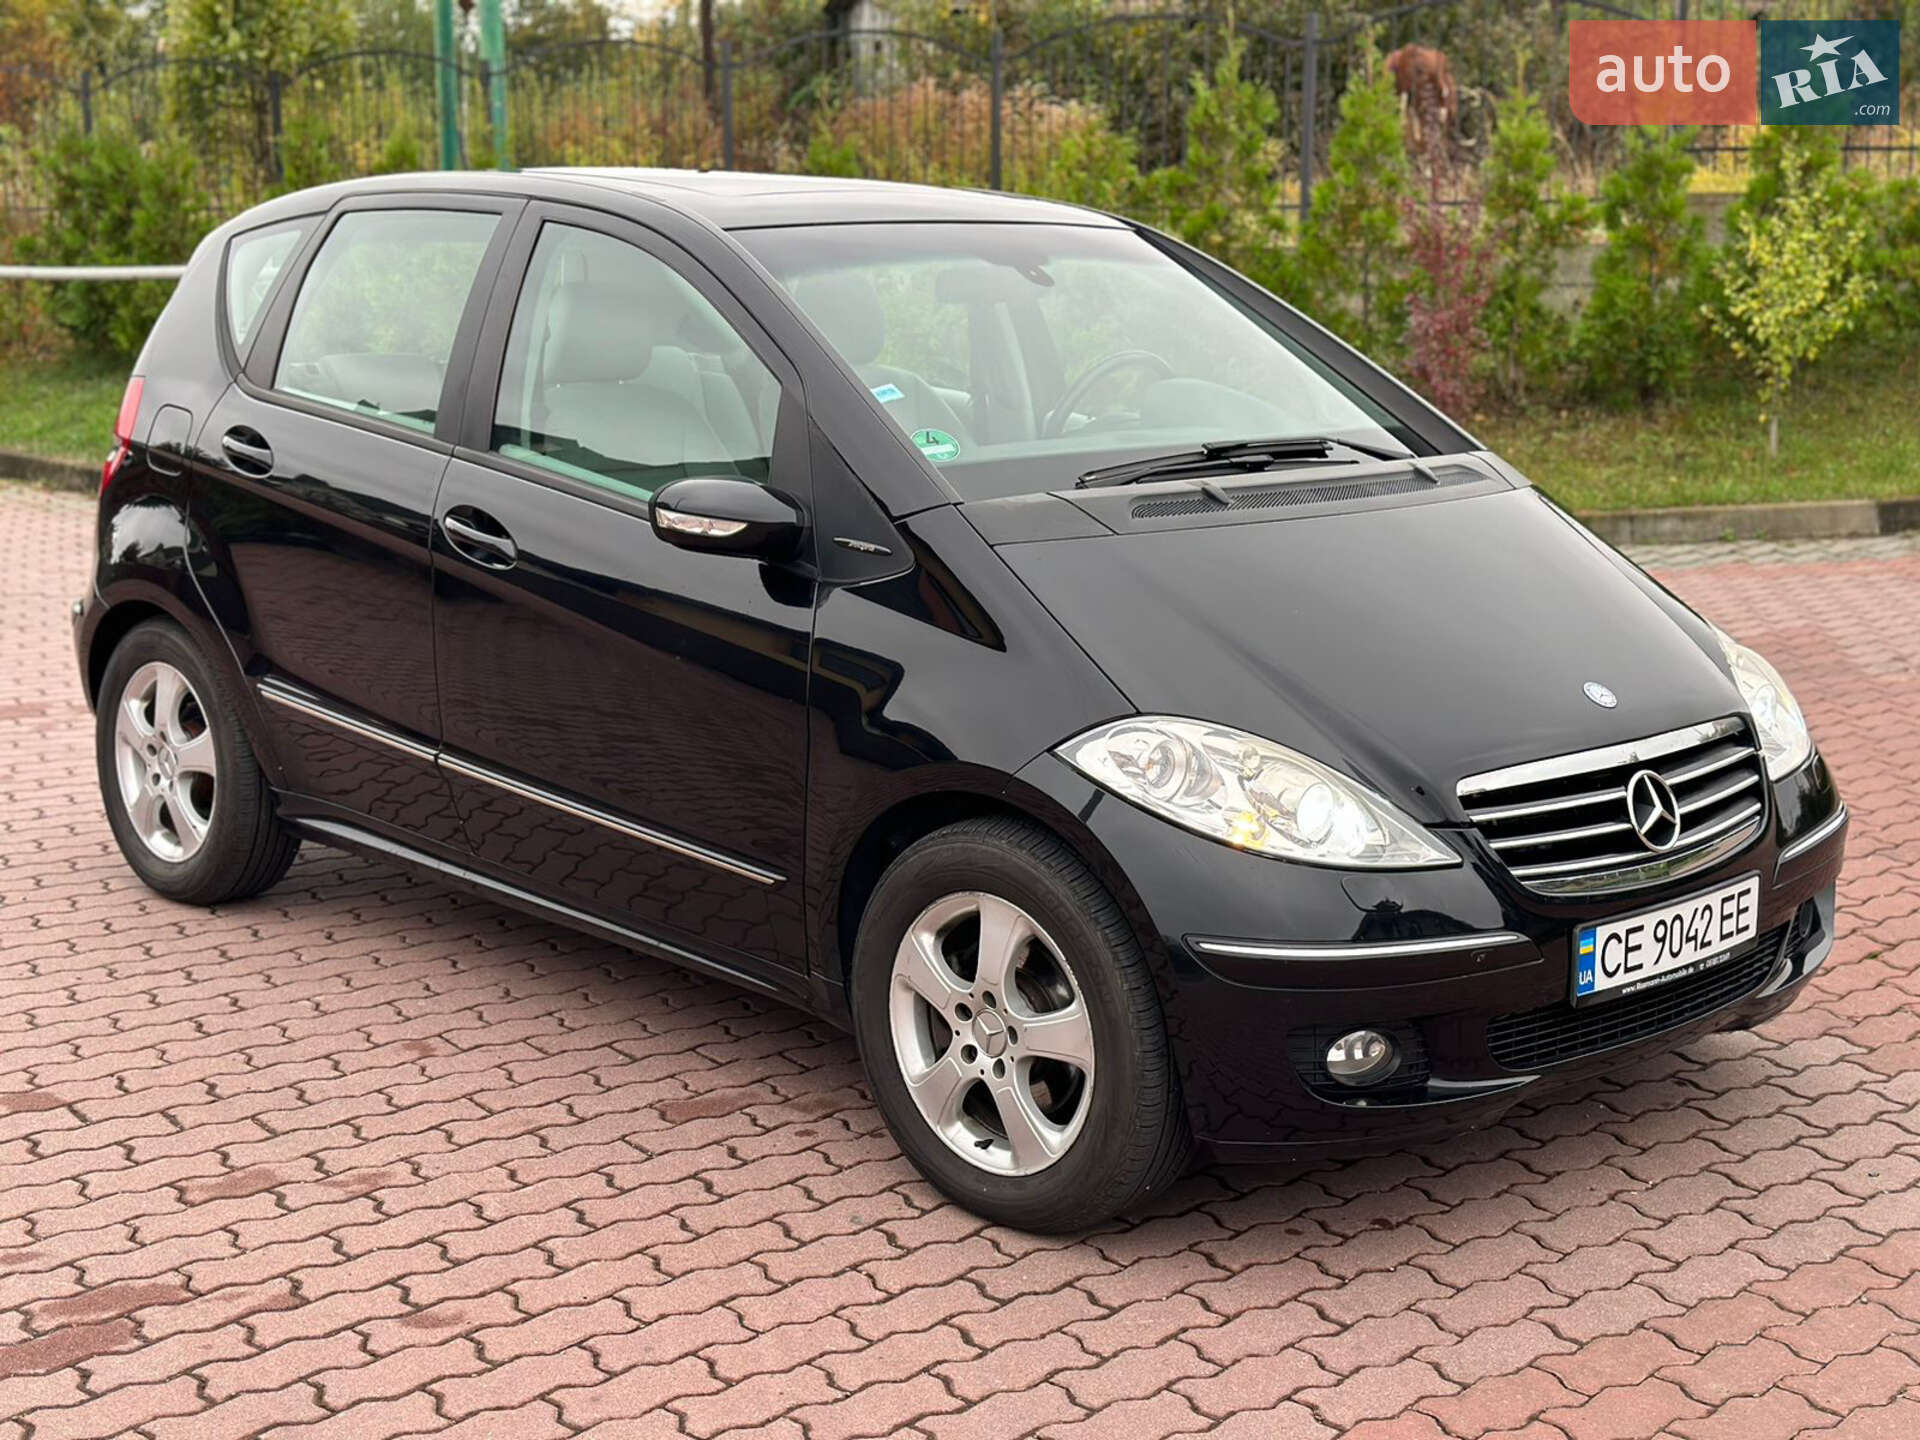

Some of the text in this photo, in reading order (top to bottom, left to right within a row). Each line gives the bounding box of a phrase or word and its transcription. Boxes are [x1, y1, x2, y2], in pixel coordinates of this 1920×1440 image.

[926, 431, 940, 445] 4
[1601, 888, 1752, 978] CE 9042 EE
[1579, 969, 1593, 985] UA
